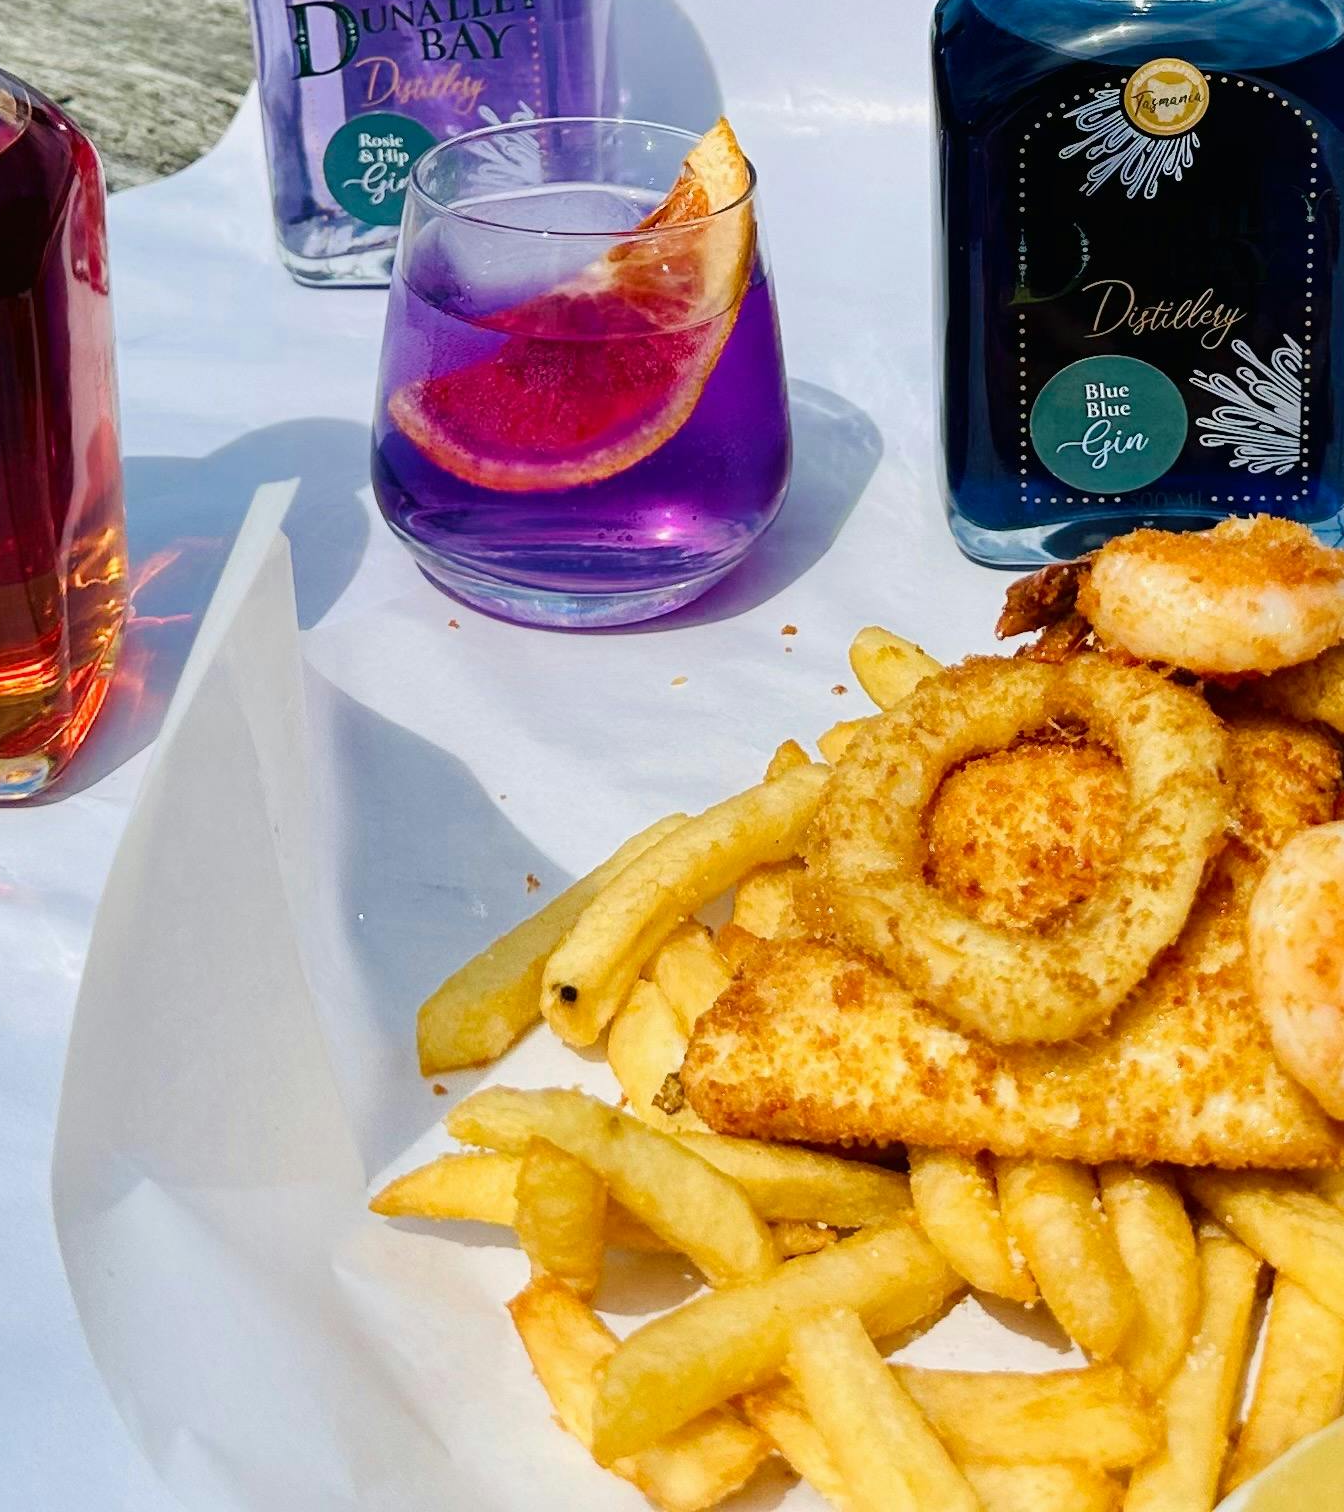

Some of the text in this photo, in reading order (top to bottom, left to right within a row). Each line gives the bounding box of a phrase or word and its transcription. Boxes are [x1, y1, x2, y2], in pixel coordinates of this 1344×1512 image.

[419, 19, 520, 61] BAY
[355, 56, 489, 115] Distillery
[1131, 90, 1205, 117] Tasmania
[358, 133, 404, 148] Rosie
[358, 148, 375, 164] &
[1082, 279, 1248, 350] Distillery
[1084, 382, 1130, 400] Blue
[1086, 400, 1131, 418] Blue
[1056, 419, 1150, 470] Gin
